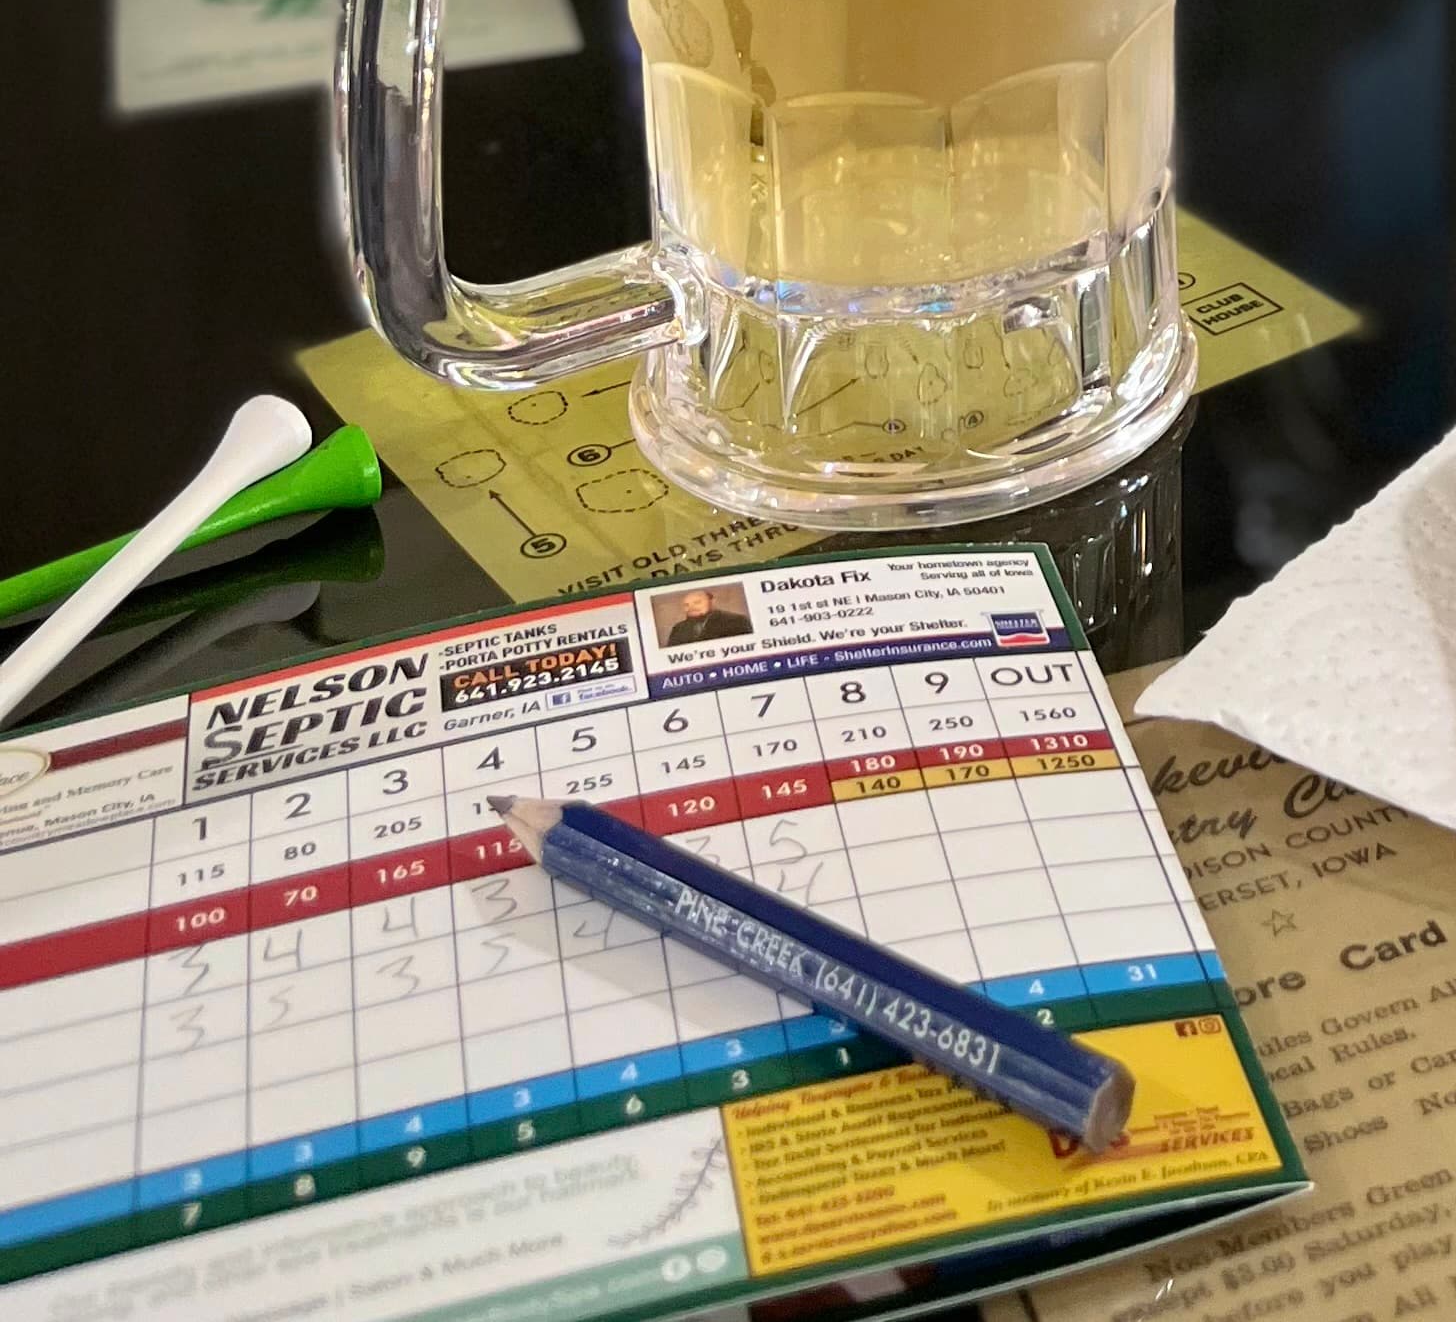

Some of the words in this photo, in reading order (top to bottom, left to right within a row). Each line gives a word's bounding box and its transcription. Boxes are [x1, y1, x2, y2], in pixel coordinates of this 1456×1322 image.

[1196, 293, 1245, 314] CLUB
[1202, 300, 1264, 326] HOUSE
[578, 447, 602, 462] 6
[531, 537, 555, 553] 5
[632, 543, 685, 569] OLD
[692, 516, 761, 548] THRE
[761, 573, 834, 593] Dakota
[841, 568, 871, 584] Fix
[887, 562, 913, 573] Your
[918, 560, 982, 570] hometown
[986, 558, 1030, 570] agency
[920, 570, 967, 582] Serving
[971, 569, 986, 578] all
[1004, 568, 1034, 577] Iowa
[832, 595, 852, 607] NE
[865, 591, 910, 603] Mason
[913, 588, 943, 601] City,
[946, 587, 961, 597] IA
[963, 585, 1005, 596] 50401
[502, 624, 557, 645] TANKS
[769, 607, 874, 628] 641-903-0222
[502, 639, 554, 659] POTTY
[557, 624, 628, 648] RENTALS
[668, 647, 716, 664] We're
[719, 644, 755, 659] your
[761, 633, 815, 649] Shield.
[819, 626, 866, 641] We're
[870, 624, 905, 638] your
[909, 618, 968, 632] Shelter.
[455, 663, 515, 689] CALL
[525, 643, 617, 671] TODAY!
[455, 657, 619, 704] 641.923.2145
[662, 672, 704, 689] AUTO
[722, 661, 768, 678] HOME
[787, 655, 818, 669] LIFE
[834, 636, 992, 662] ShelterInsurance.com
[207, 655, 429, 730] NELSON
[200, 687, 427, 772] SEPTIC
[443, 706, 515, 731] Garner,
[520, 700, 541, 715] IA
[193, 817, 207, 840] 1
[285, 792, 312, 818] 2
[383, 770, 409, 794] 3
[477, 748, 503, 770] 4
[571, 727, 597, 751] 5
[662, 709, 689, 734] 6
[751, 693, 777, 718] 7
[840, 680, 867, 703] 8
[924, 672, 950, 694] 9
[990, 664, 1073, 687] OUT
[193, 736, 361, 791] SERVICES
[369, 721, 428, 748] LLC
[137, 765, 174, 780] Care
[856, 775, 901, 793] 140
[946, 763, 990, 779] 170
[1037, 754, 1095, 770] 1250
[139, 793, 156, 803] IA
[178, 864, 225, 885] 115
[284, 841, 317, 860] 80
[374, 817, 422, 838] 205
[566, 774, 614, 793] 255
[662, 754, 707, 774] 145
[754, 738, 798, 757] 170
[841, 725, 887, 743] 210
[929, 715, 974, 731] 250
[1020, 706, 1077, 722] 1560
[176, 908, 225, 930] 100
[284, 886, 317, 906] 70
[377, 861, 425, 883] 165
[476, 839, 521, 859] 115
[668, 796, 716, 818] 120
[762, 779, 808, 799] 145
[850, 755, 896, 772] 180
[939, 743, 984, 760] 190
[1030, 734, 1089, 750] 1310
[1198, 870, 1301, 911] ERSET,
[1312, 842, 1397, 877] IOWA
[264, 929, 301, 972] 4
[383, 897, 417, 937] 4
[472, 878, 517, 922] 3
[1339, 920, 1448, 972] Card
[736, 915, 804, 978] CREEK
[815, 954, 879, 1014] (641)
[883, 991, 1001, 1075] 423-6831
[620, 1063, 639, 1081] 4
[727, 1040, 742, 1057] 3
[1029, 979, 1045, 995] 4
[1128, 964, 1157, 982] 31
[1321, 996, 1420, 1037] Govern
[733, 1071, 749, 1088] 3
[1037, 1009, 1054, 1025] 2
[1329, 1026, 1416, 1063] Rules.
[1281, 1085, 1354, 1118] Bags
[1368, 1071, 1396, 1091] or
[1159, 1127, 1255, 1151] SERVICES
[1303, 1114, 1389, 1153] Shoes
[1366, 1168, 1454, 1206] Green
[1319, 1262, 1376, 1298] you
[1395, 1285, 1438, 1317] All
